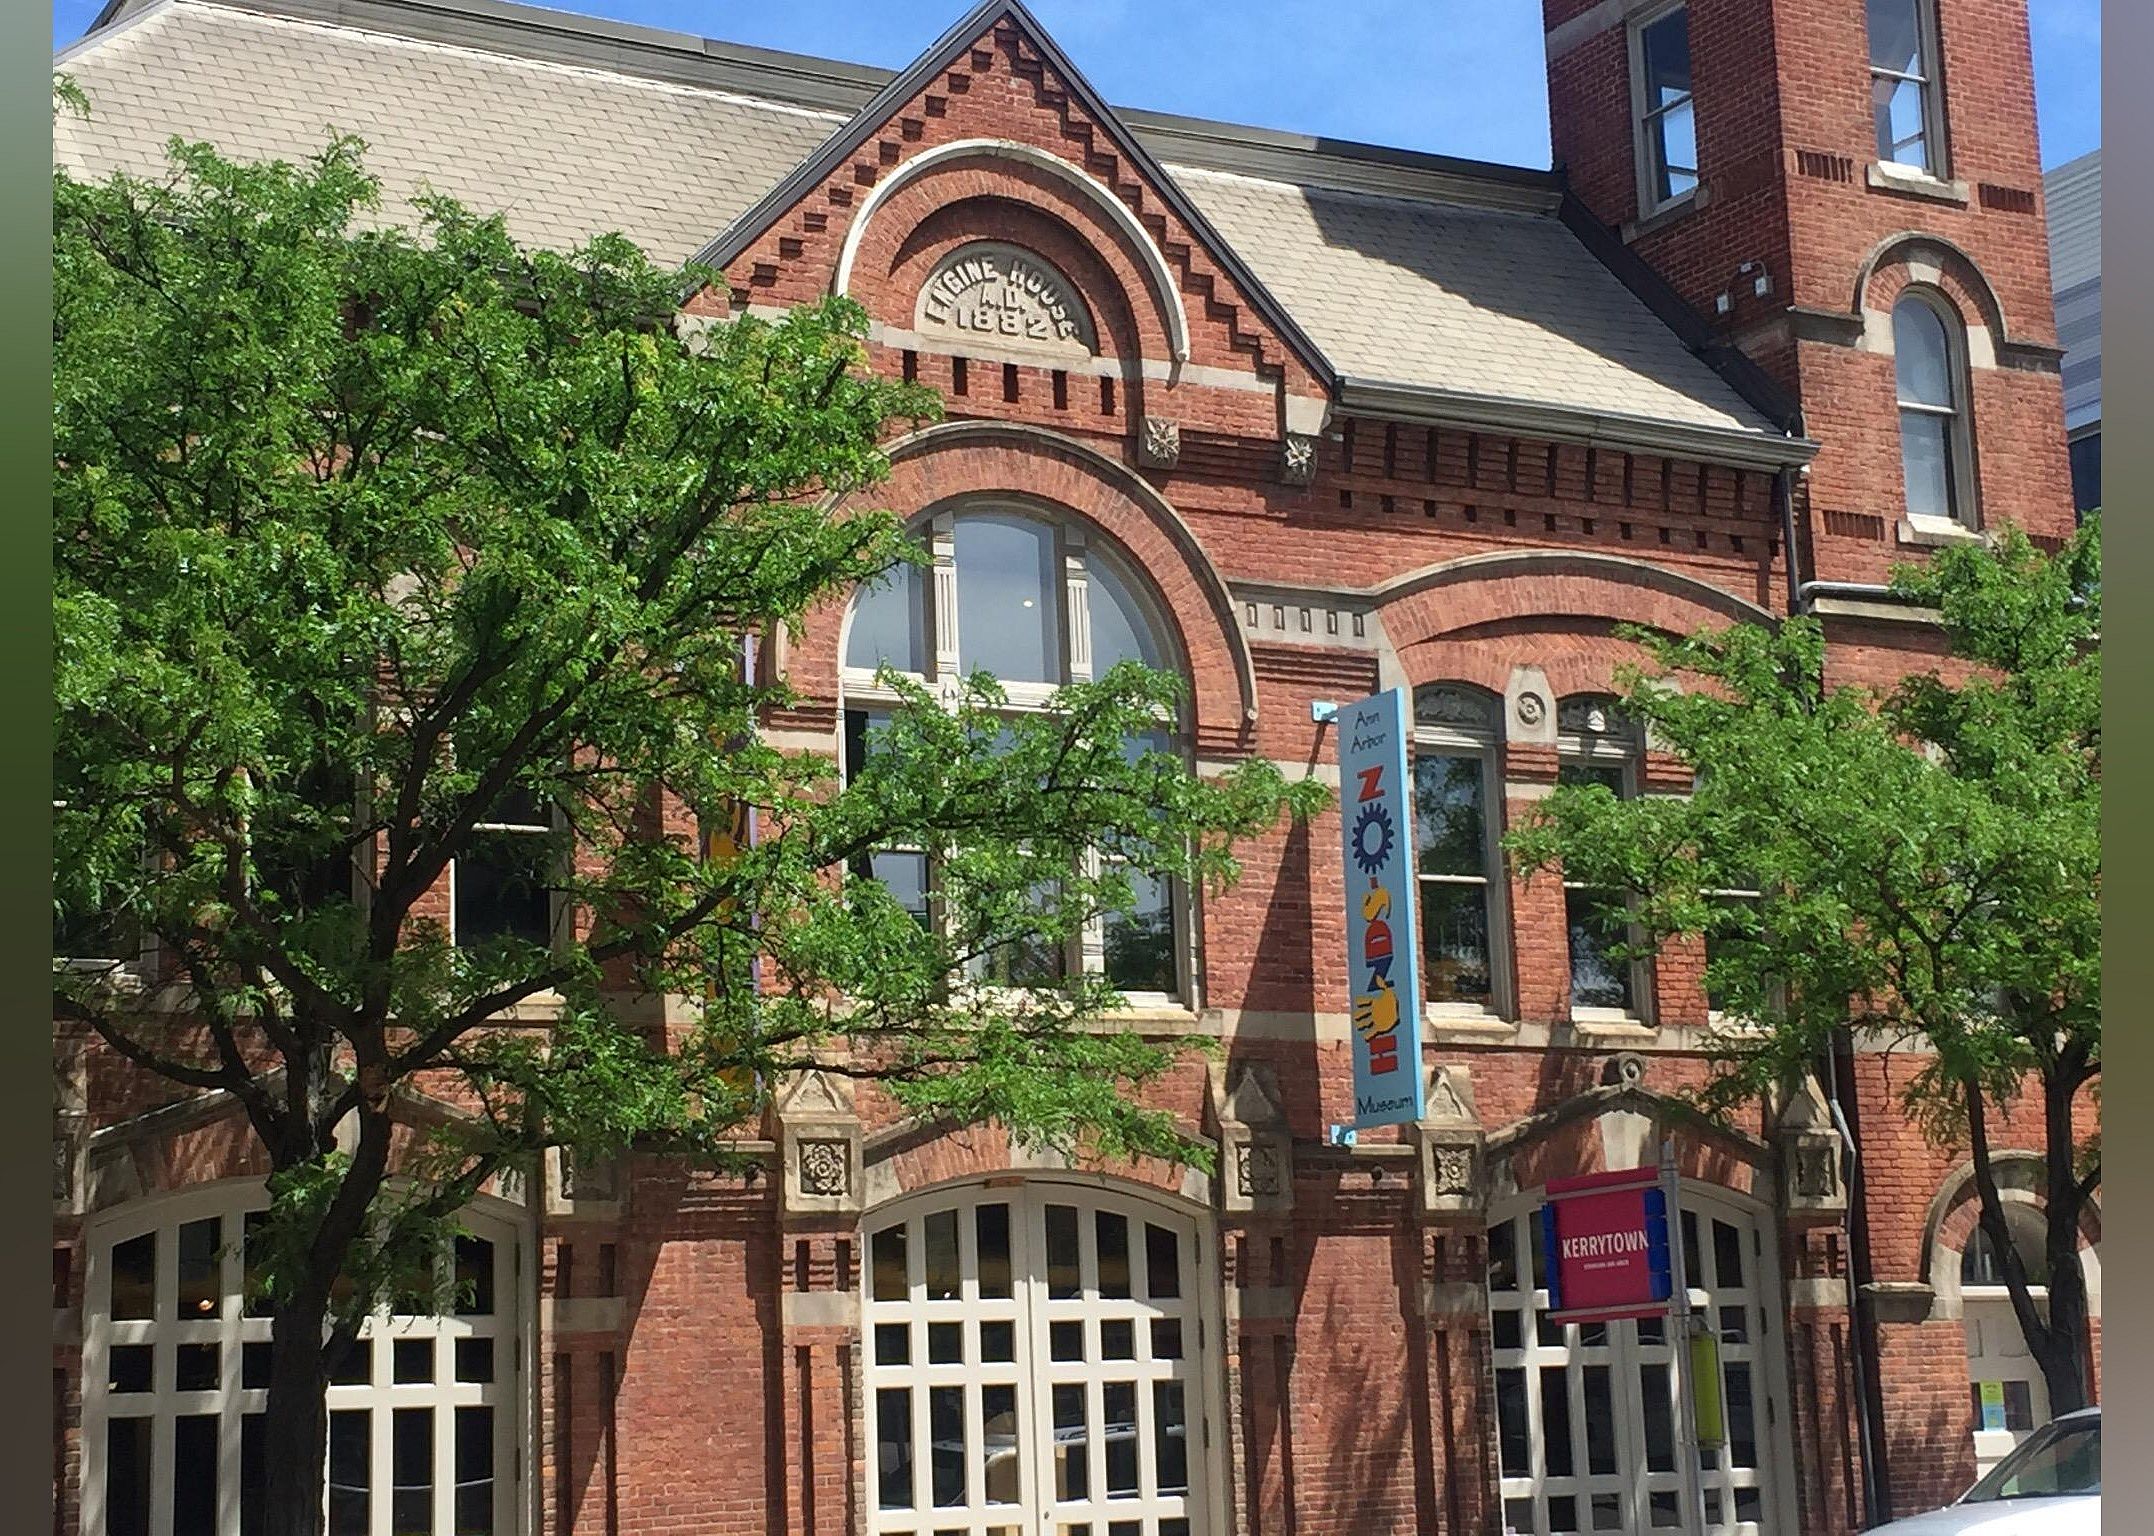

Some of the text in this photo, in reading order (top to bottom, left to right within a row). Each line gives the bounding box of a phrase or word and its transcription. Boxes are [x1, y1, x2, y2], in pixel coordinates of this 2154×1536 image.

[925, 255, 1080, 340] ENGINE HOUSE
[957, 307, 1048, 340] 1882
[1358, 1096, 1413, 1116] Museum
[1562, 1229, 1649, 1260] KERRYTOWN
